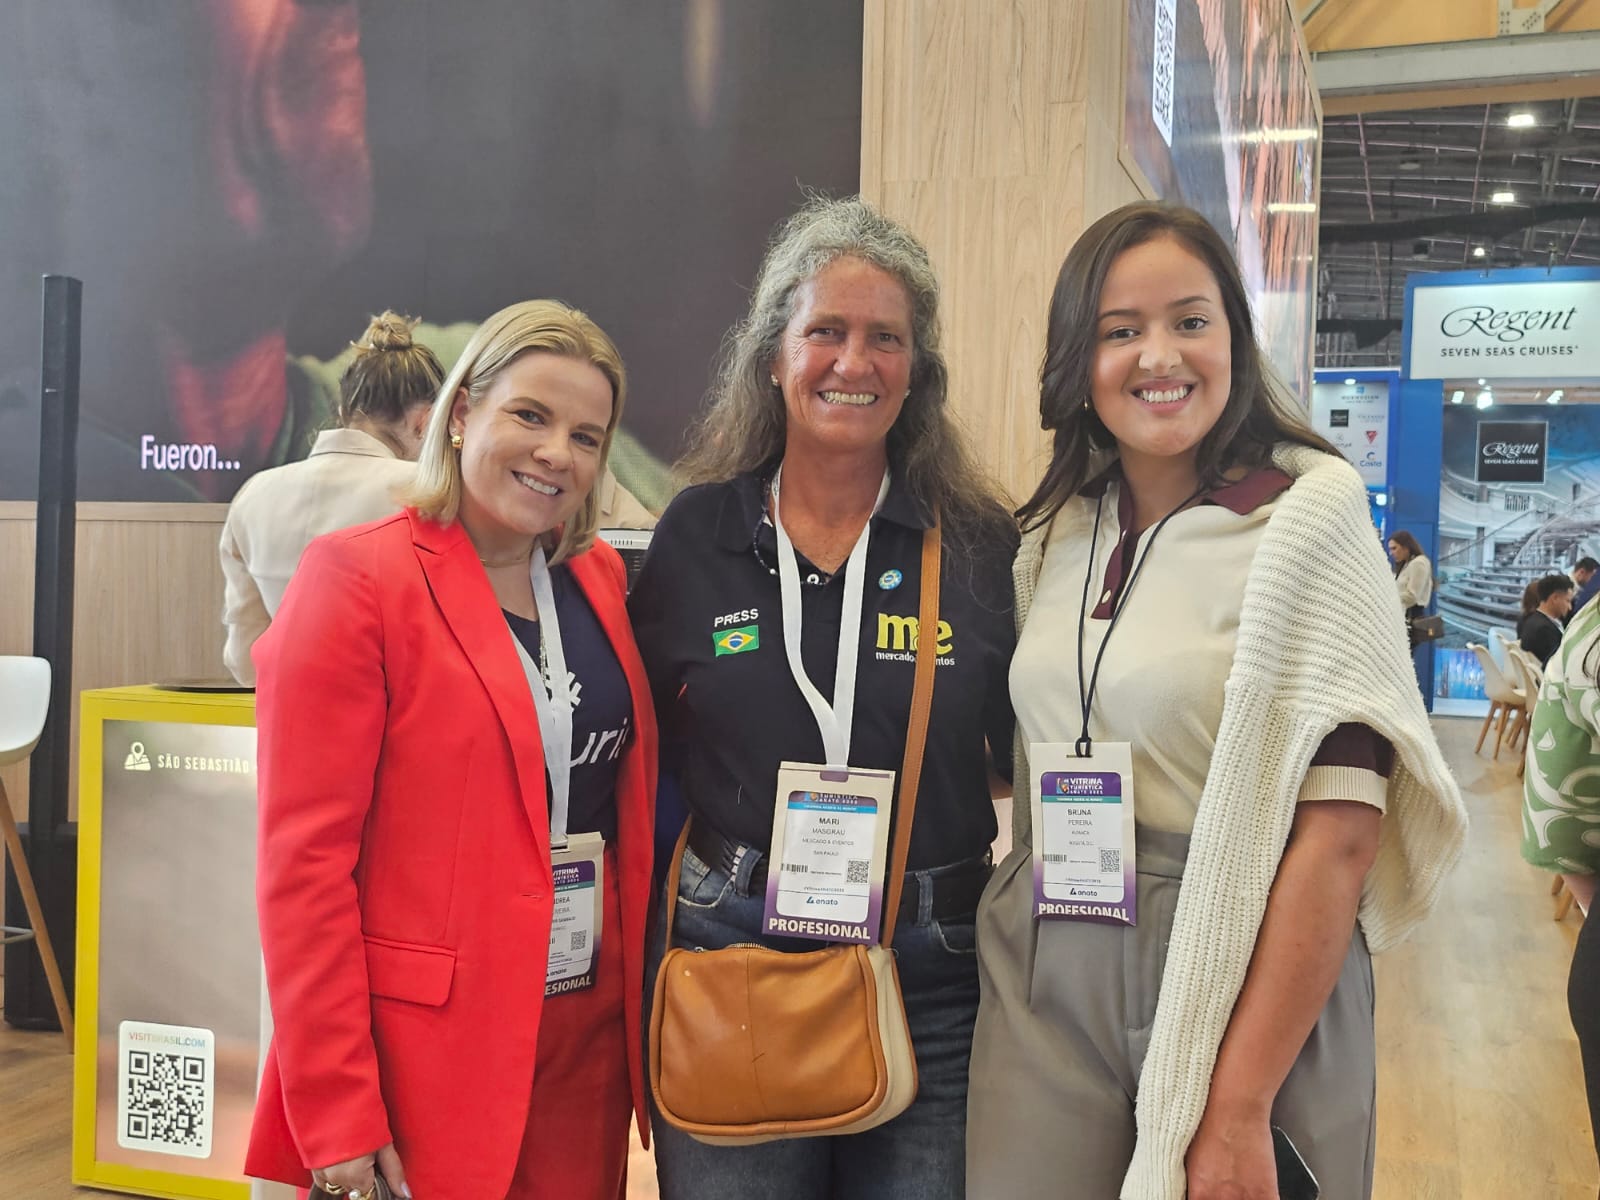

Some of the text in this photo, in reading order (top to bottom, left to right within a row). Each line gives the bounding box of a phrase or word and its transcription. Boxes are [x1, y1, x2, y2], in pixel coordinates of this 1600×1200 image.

[1440, 306, 1578, 342] Regent
[1440, 348, 1480, 357] SEVEN
[1485, 347, 1515, 356] SEAS
[141, 435, 240, 470] Fueron...
[1482, 442, 1539, 459] Regent
[714, 608, 759, 628] PRESS
[875, 651, 915, 662] mercado
[157, 753, 250, 774] SÃO SEBASTIÃO
[1070, 777, 1103, 785] VITRINA
[819, 817, 840, 826] MARI
[768, 917, 872, 940] PROFESIONAL
[545, 975, 592, 996] ESIONAL
[128, 1031, 206, 1049] VISITBRASIL.COM
